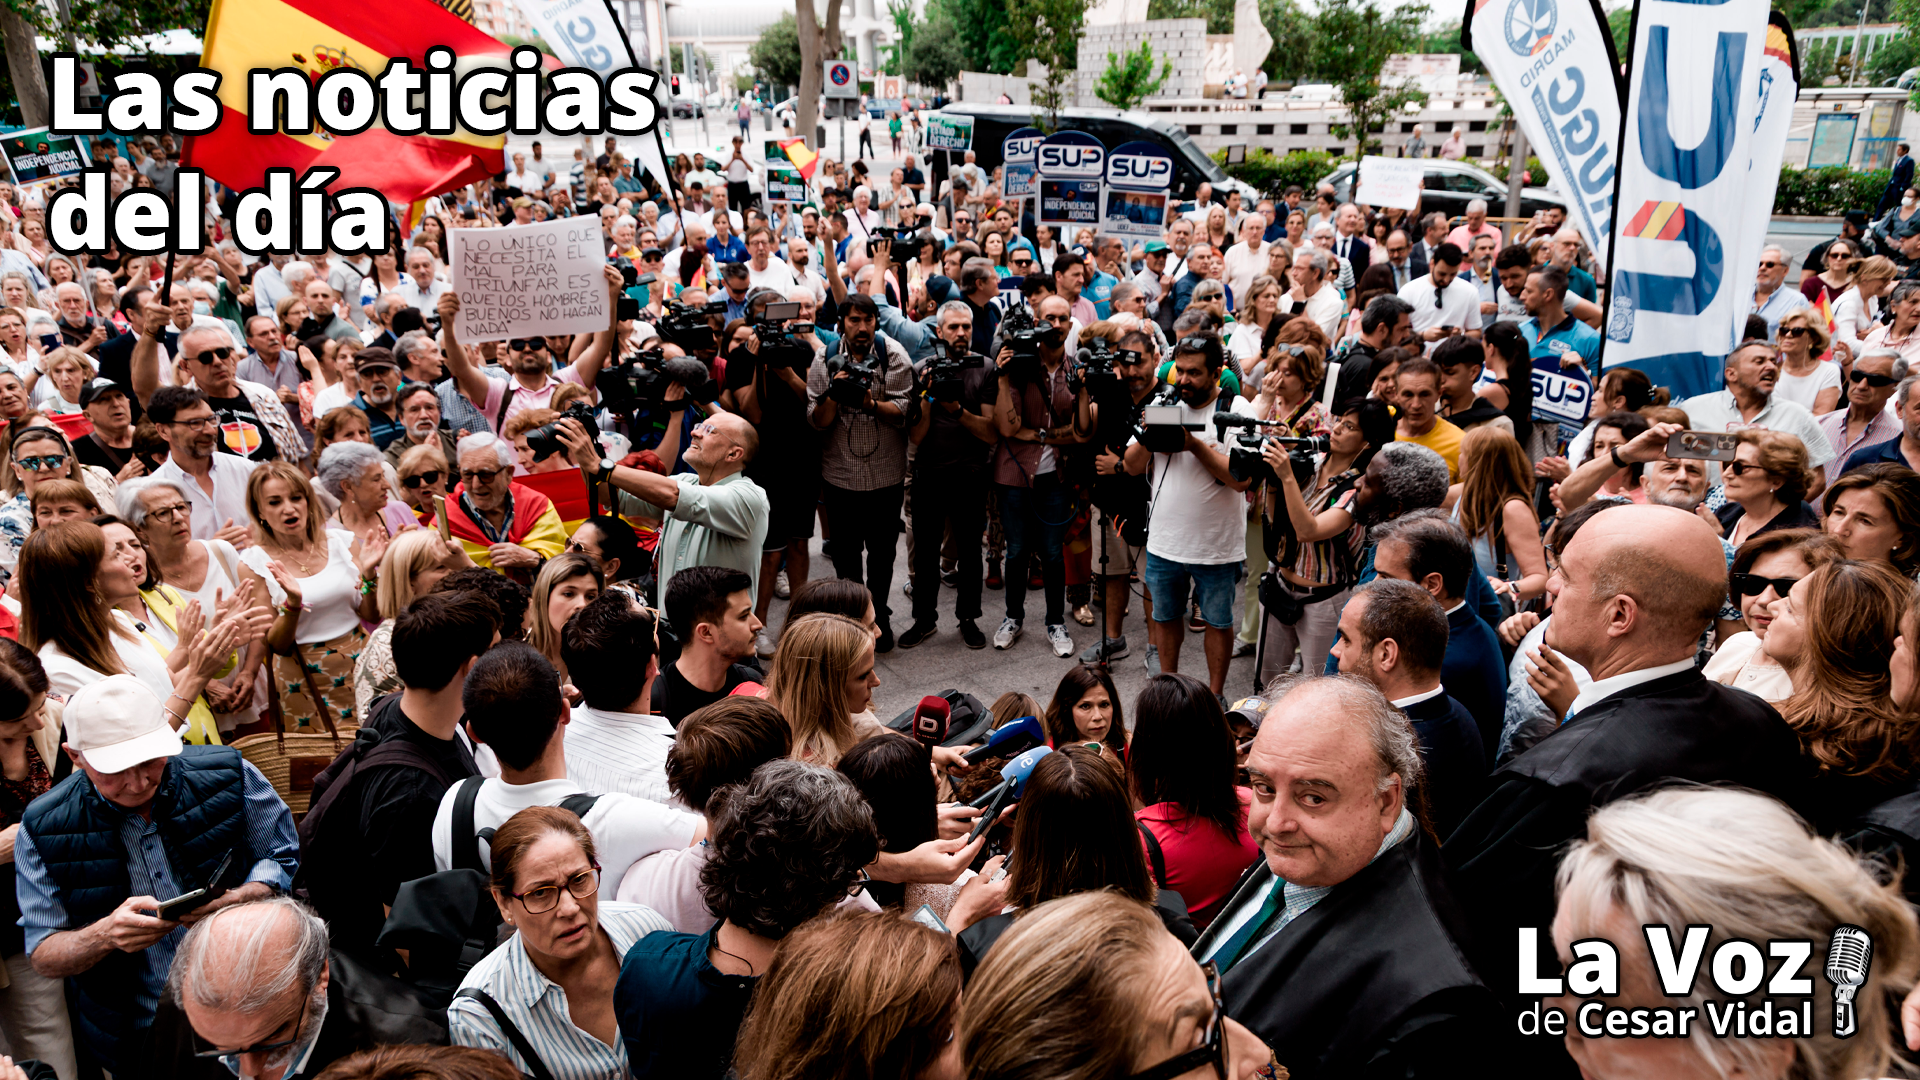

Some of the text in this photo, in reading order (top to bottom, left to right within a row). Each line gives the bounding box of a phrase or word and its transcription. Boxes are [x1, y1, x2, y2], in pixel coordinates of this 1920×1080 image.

[930, 126, 955, 137] ESTADO
[930, 136, 966, 148] DERECHO
[14, 149, 79, 171] INDEPENDENCIA
[1042, 147, 1101, 168] SUP
[48, 160, 82, 175] JUDICIAL
[1112, 158, 1169, 179] SUP
[1008, 173, 1030, 183] ESTADO
[1008, 182, 1036, 194] DERECH
[1044, 200, 1096, 211] INDEPENDENCIA
[1068, 210, 1096, 220] JUDICIAL
[567, 227, 595, 243] QUE
[464, 244, 586, 265] NECESITA EL
[464, 263, 557, 278] MAL PARA
[466, 273, 591, 292] TRIUNFAR ES
[461, 290, 599, 308] QUE LOS HOMBRES
[465, 304, 602, 321] BUENOS NO HAGAN
[1531, 371, 1586, 406] SUP
